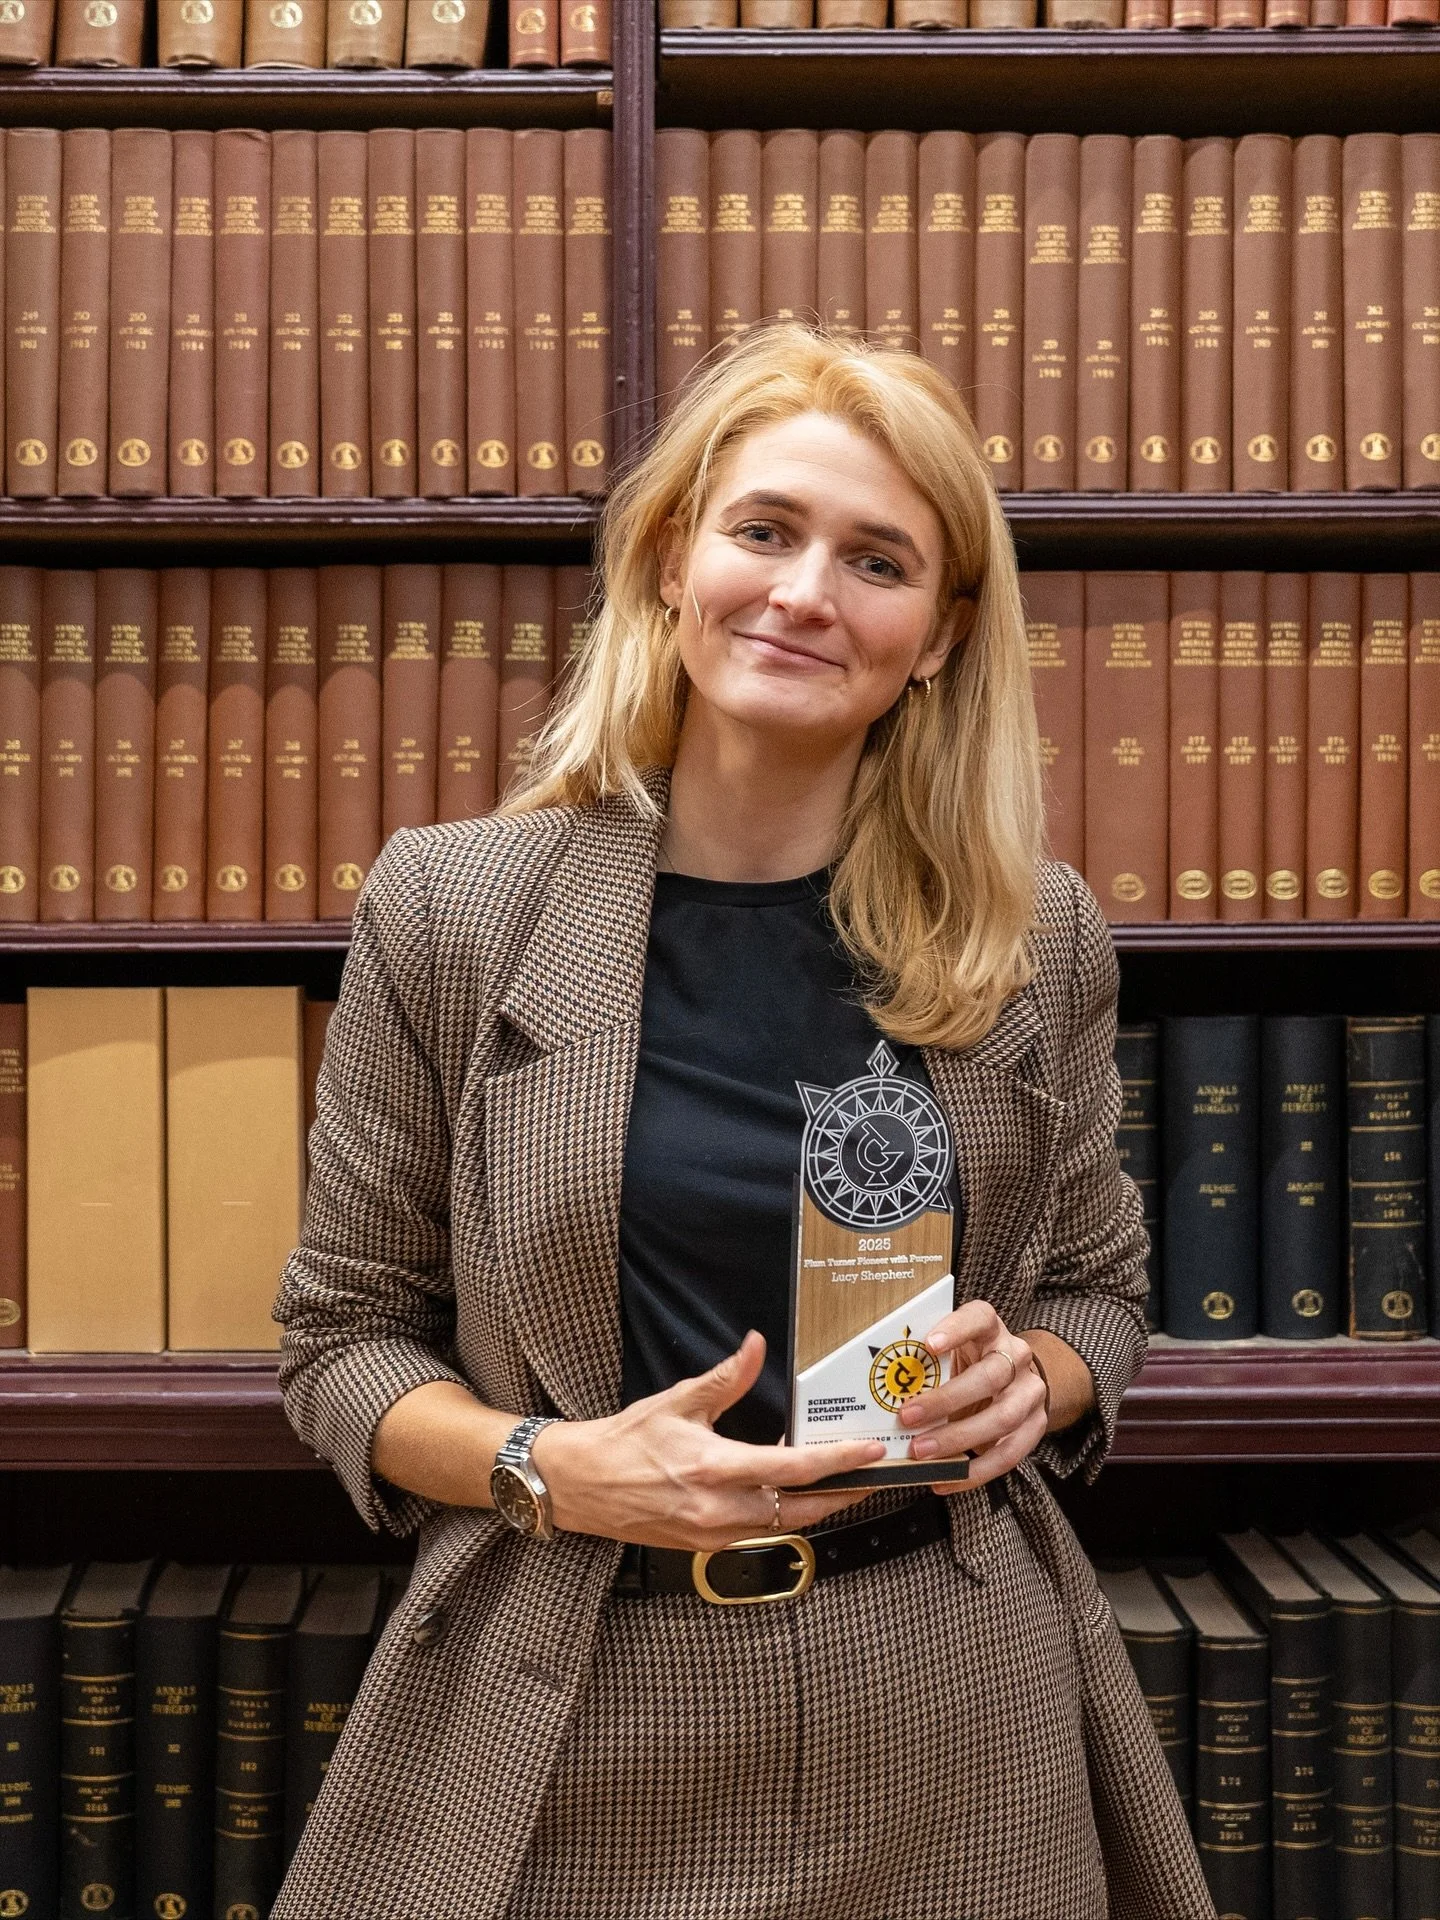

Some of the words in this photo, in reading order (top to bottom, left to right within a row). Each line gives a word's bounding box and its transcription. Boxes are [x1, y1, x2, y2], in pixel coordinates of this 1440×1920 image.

[858, 1238, 892, 1252] 2025
[856, 1256, 889, 1266] Pioneer
[890, 1255, 909, 1264] with
[909, 1254, 944, 1264] Purpose
[831, 1272, 859, 1284] Lucy
[860, 1268, 915, 1283] Shepherd
[808, 1397, 857, 1406] SCIENTIFIC
[808, 1405, 867, 1414] EXPLORATION
[807, 1414, 844, 1422] SOCIETY
[0, 1684, 34, 1695] NNALS
